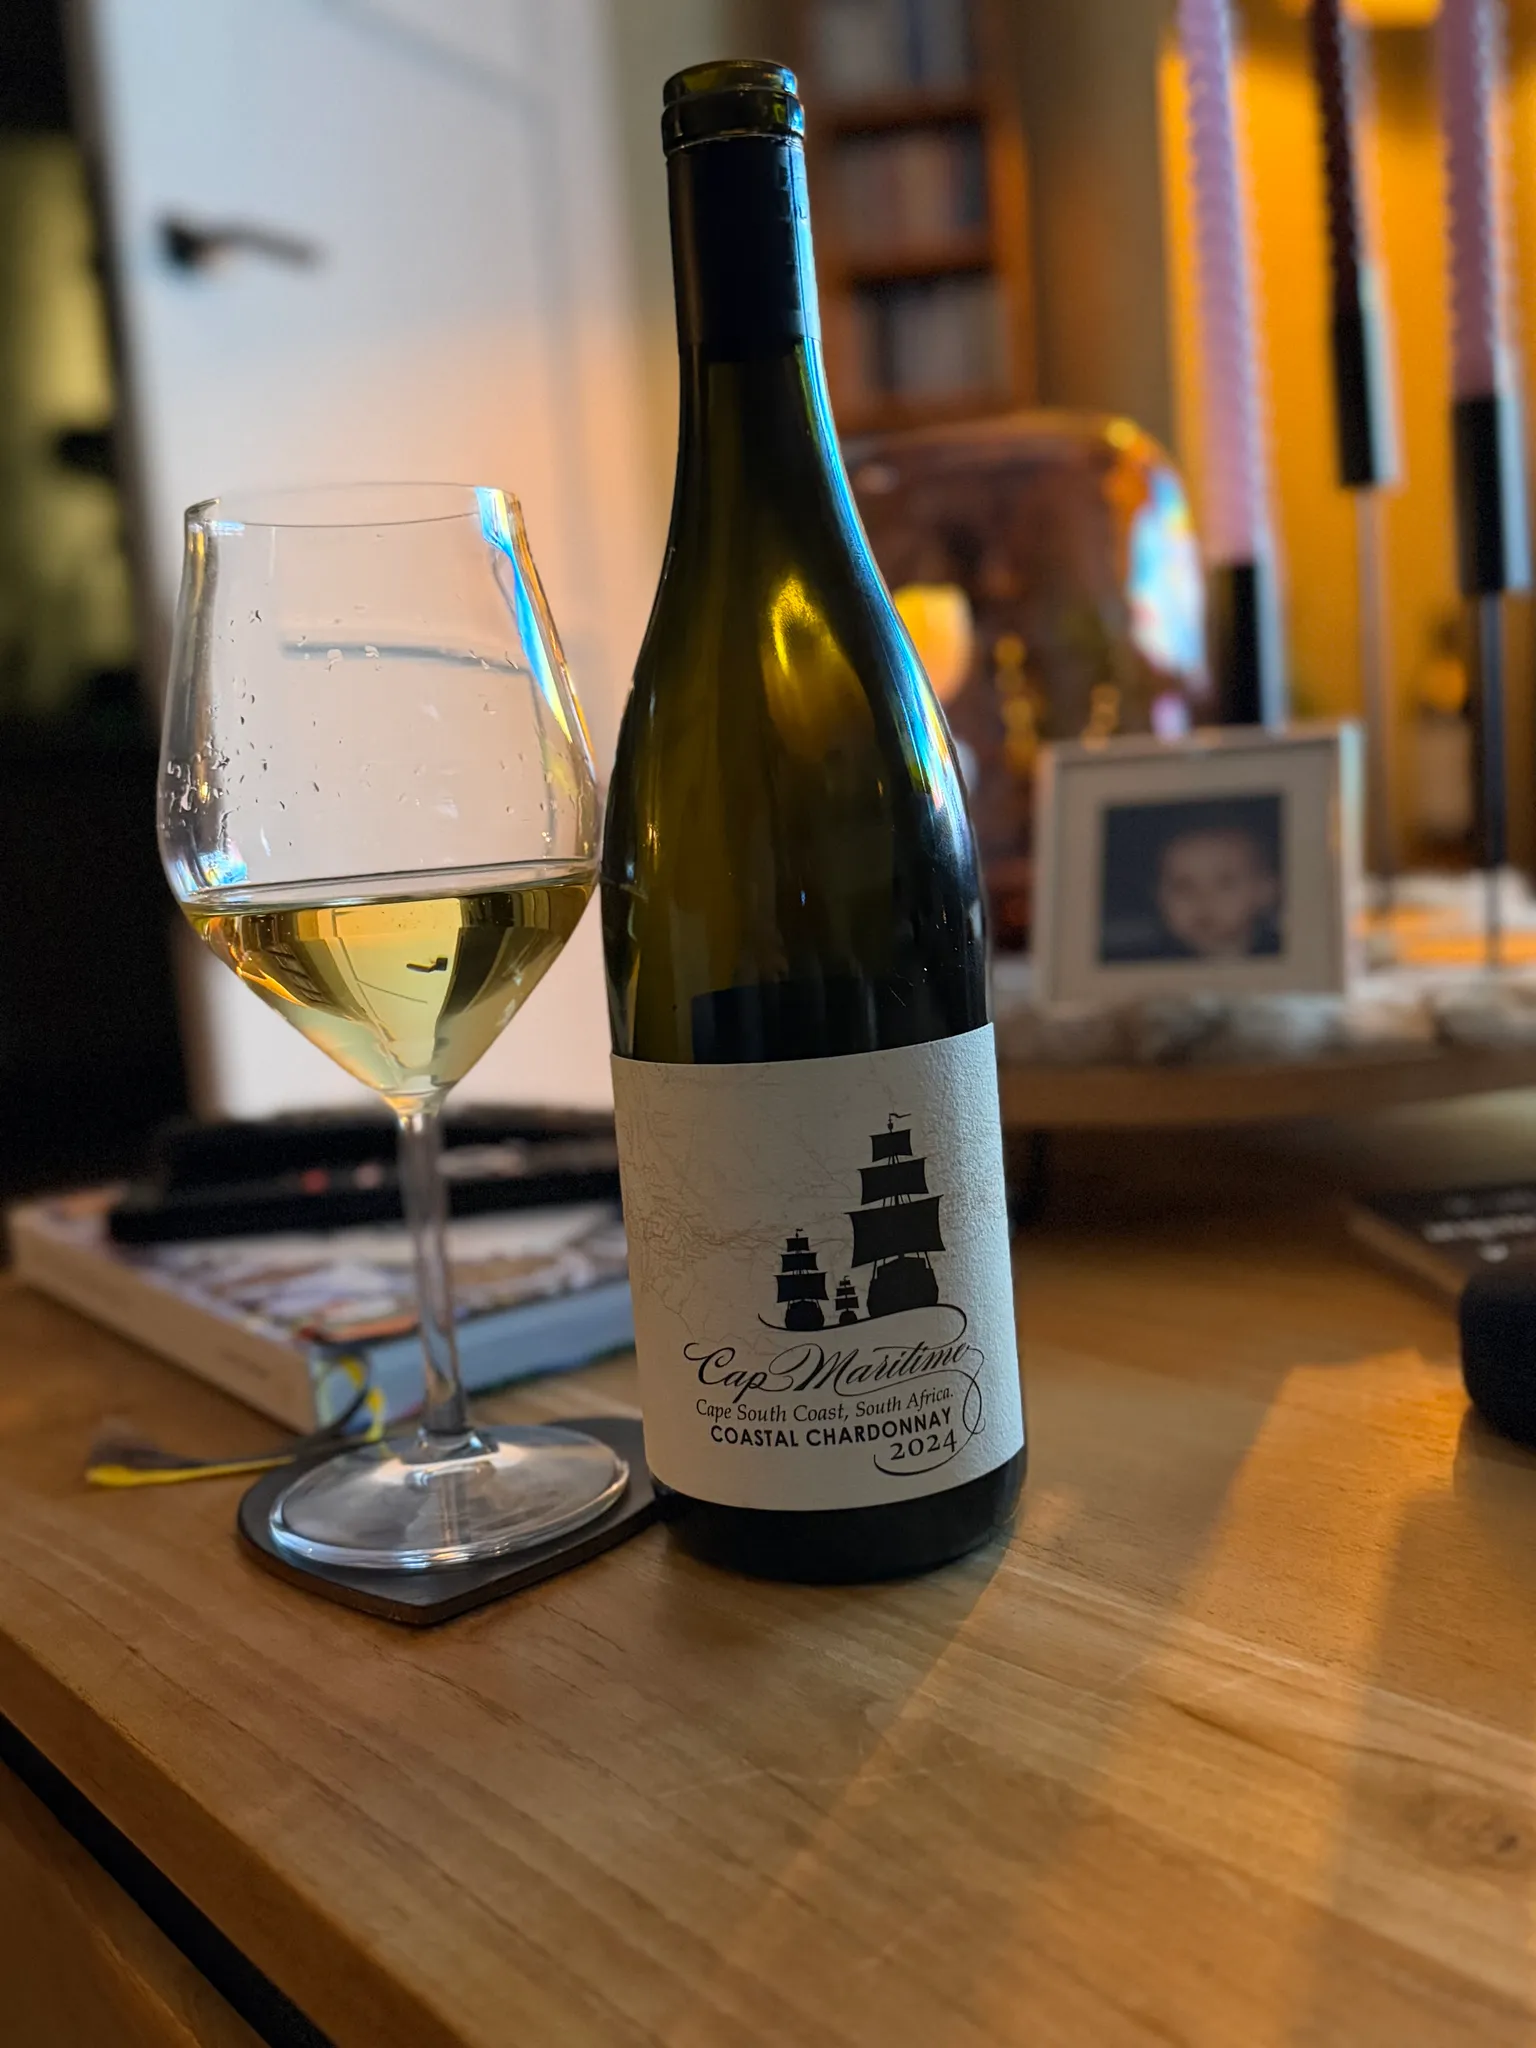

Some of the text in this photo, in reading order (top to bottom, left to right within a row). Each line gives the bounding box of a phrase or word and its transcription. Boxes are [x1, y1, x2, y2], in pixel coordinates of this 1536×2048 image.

[683, 1342, 794, 1404] Cap
[696, 1385, 954, 1422] Cape South Coast, South Africa.
[710, 1406, 952, 1448] COASTAL CHARDONNAY
[889, 1428, 958, 1461] 2024
